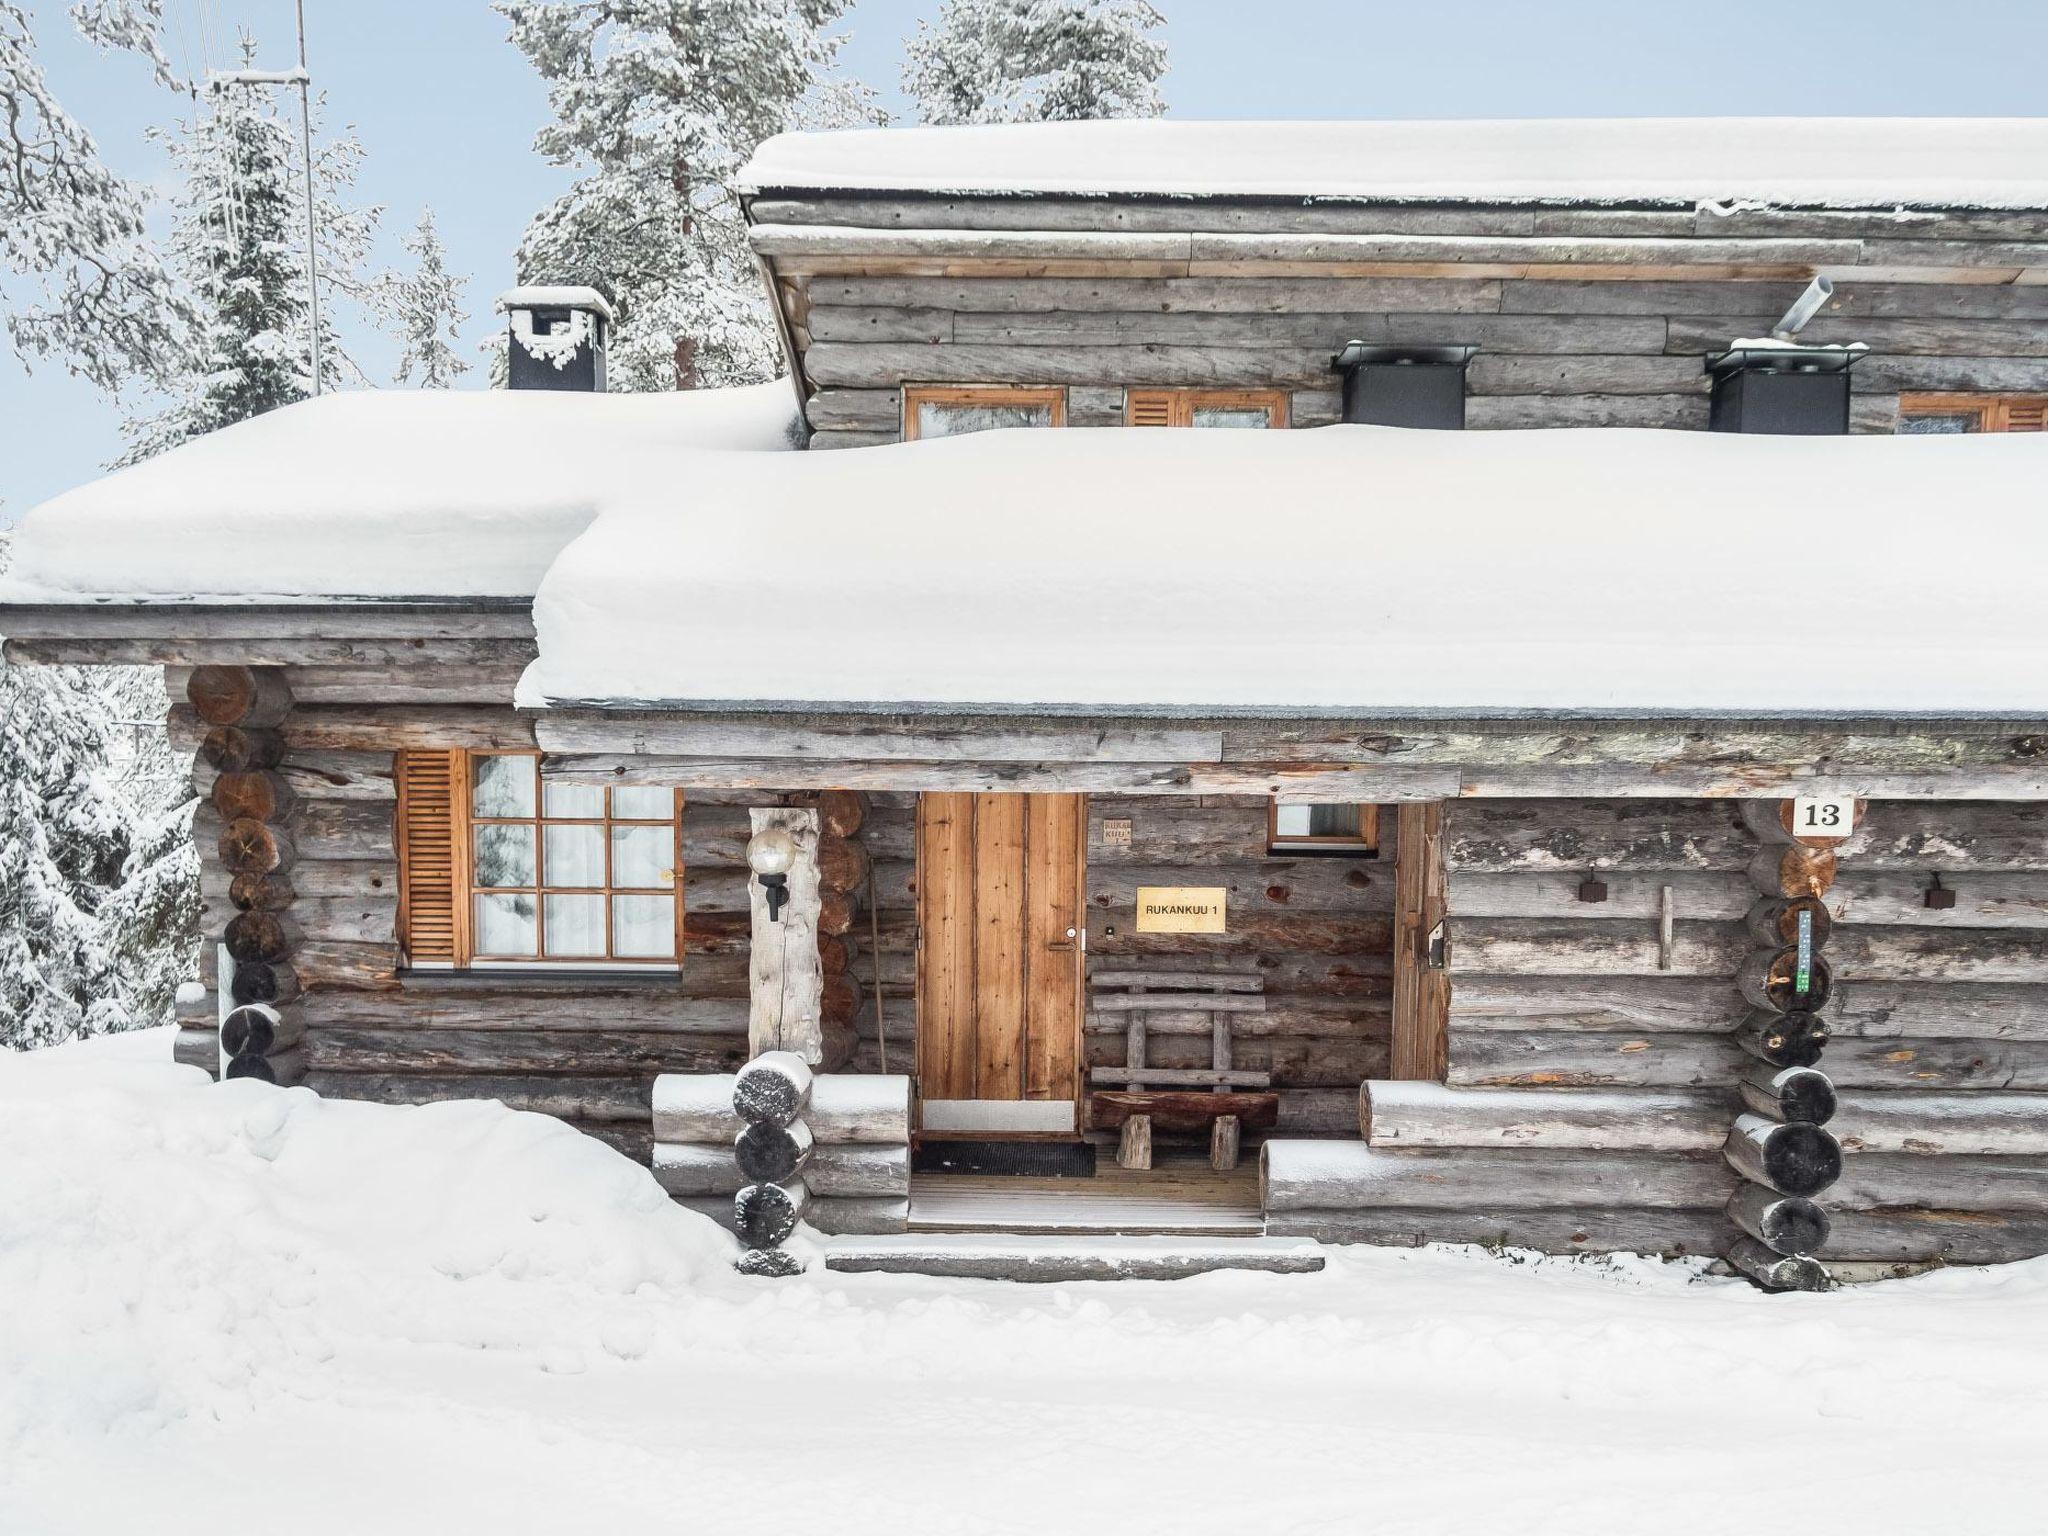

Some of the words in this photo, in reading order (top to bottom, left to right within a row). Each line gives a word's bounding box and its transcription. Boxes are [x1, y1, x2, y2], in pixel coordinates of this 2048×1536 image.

[1805, 804, 1840, 826] 13
[1146, 905, 1208, 915] RUKANKUU
[1212, 905, 1217, 915] 1
